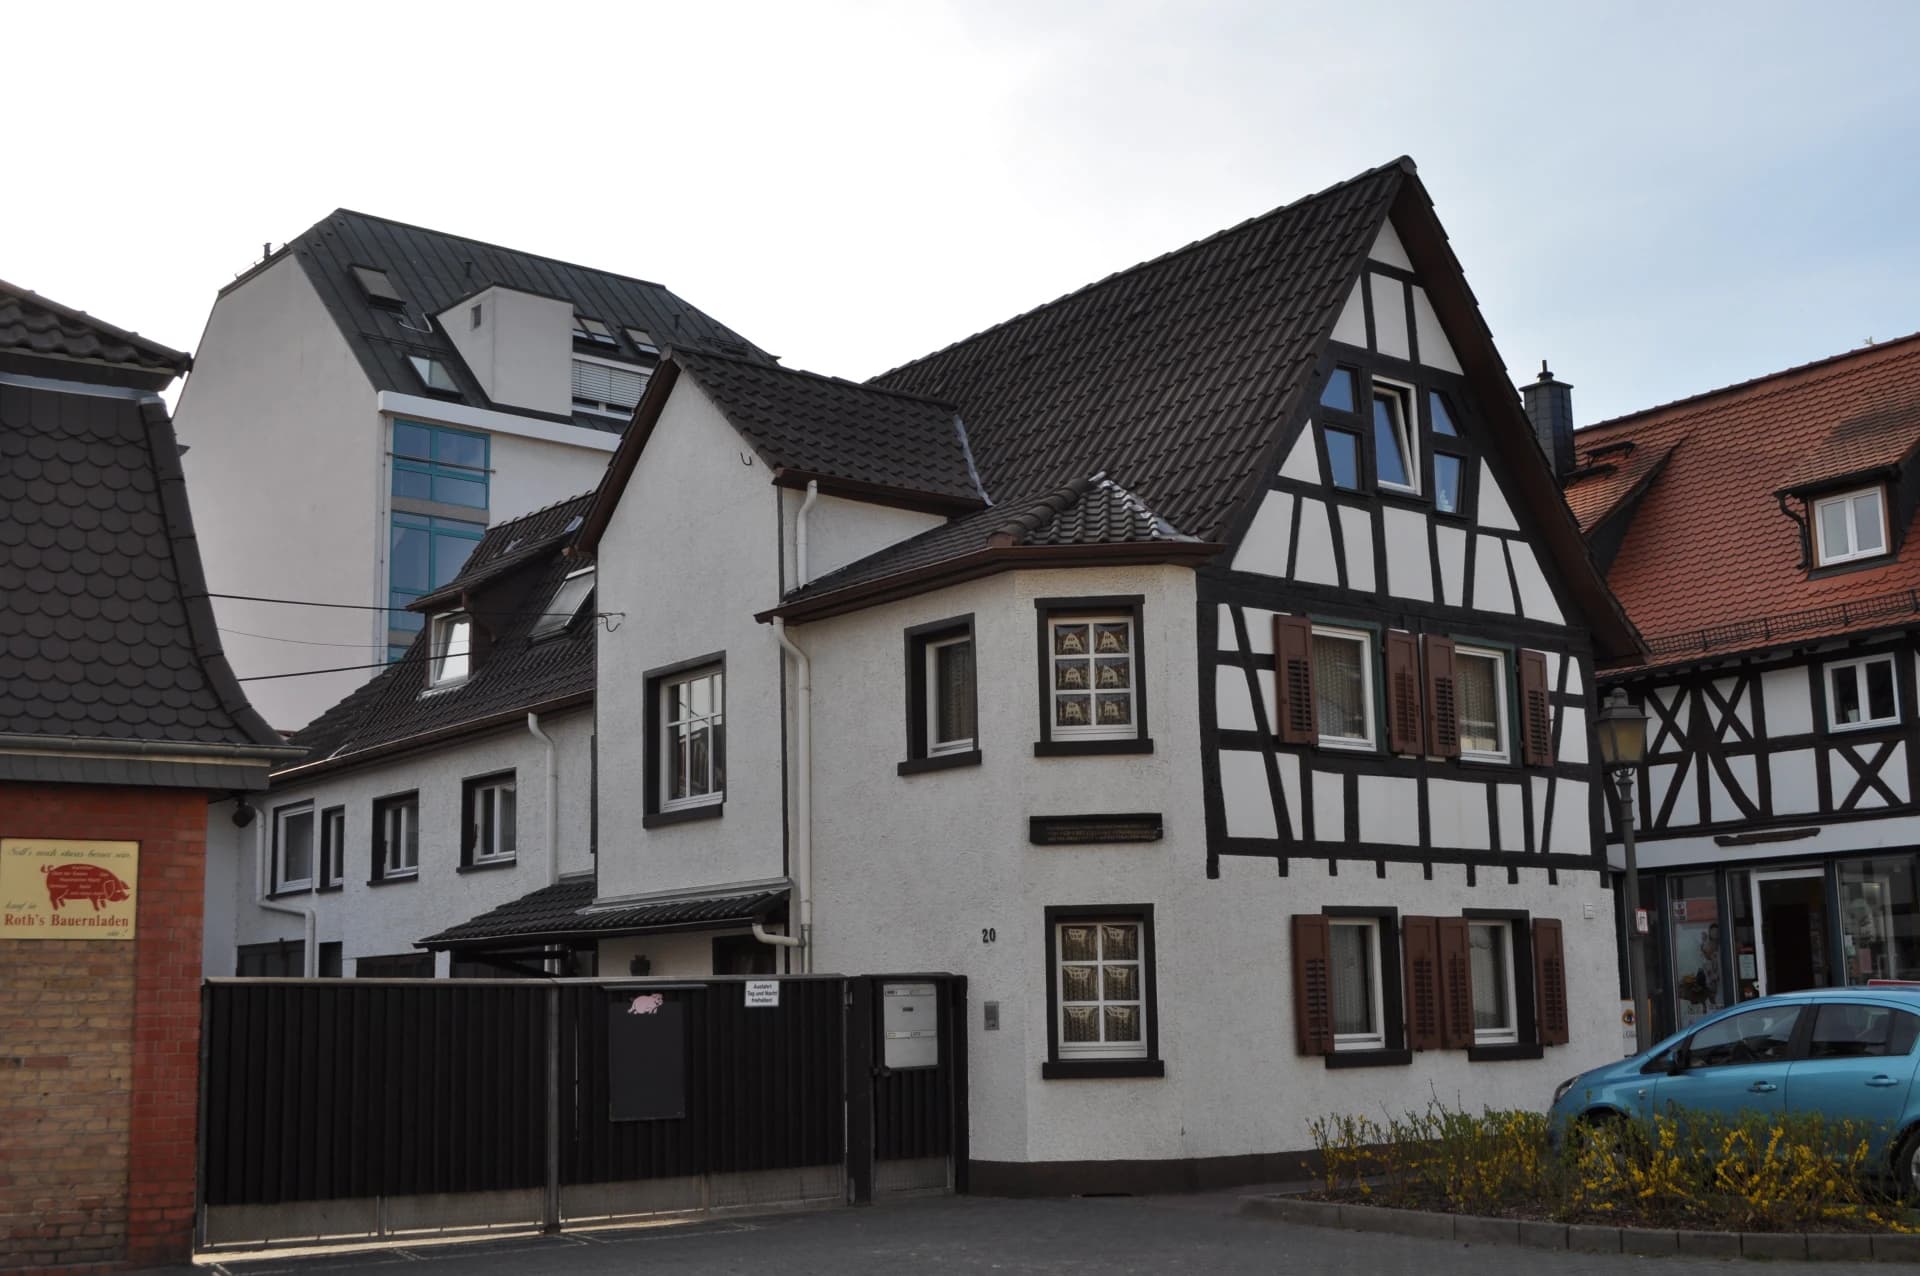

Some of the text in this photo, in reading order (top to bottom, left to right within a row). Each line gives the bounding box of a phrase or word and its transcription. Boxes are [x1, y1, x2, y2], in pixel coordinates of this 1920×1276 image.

[4, 913, 129, 927] Roth's Bauernladen
[982, 927, 996, 943] 20
